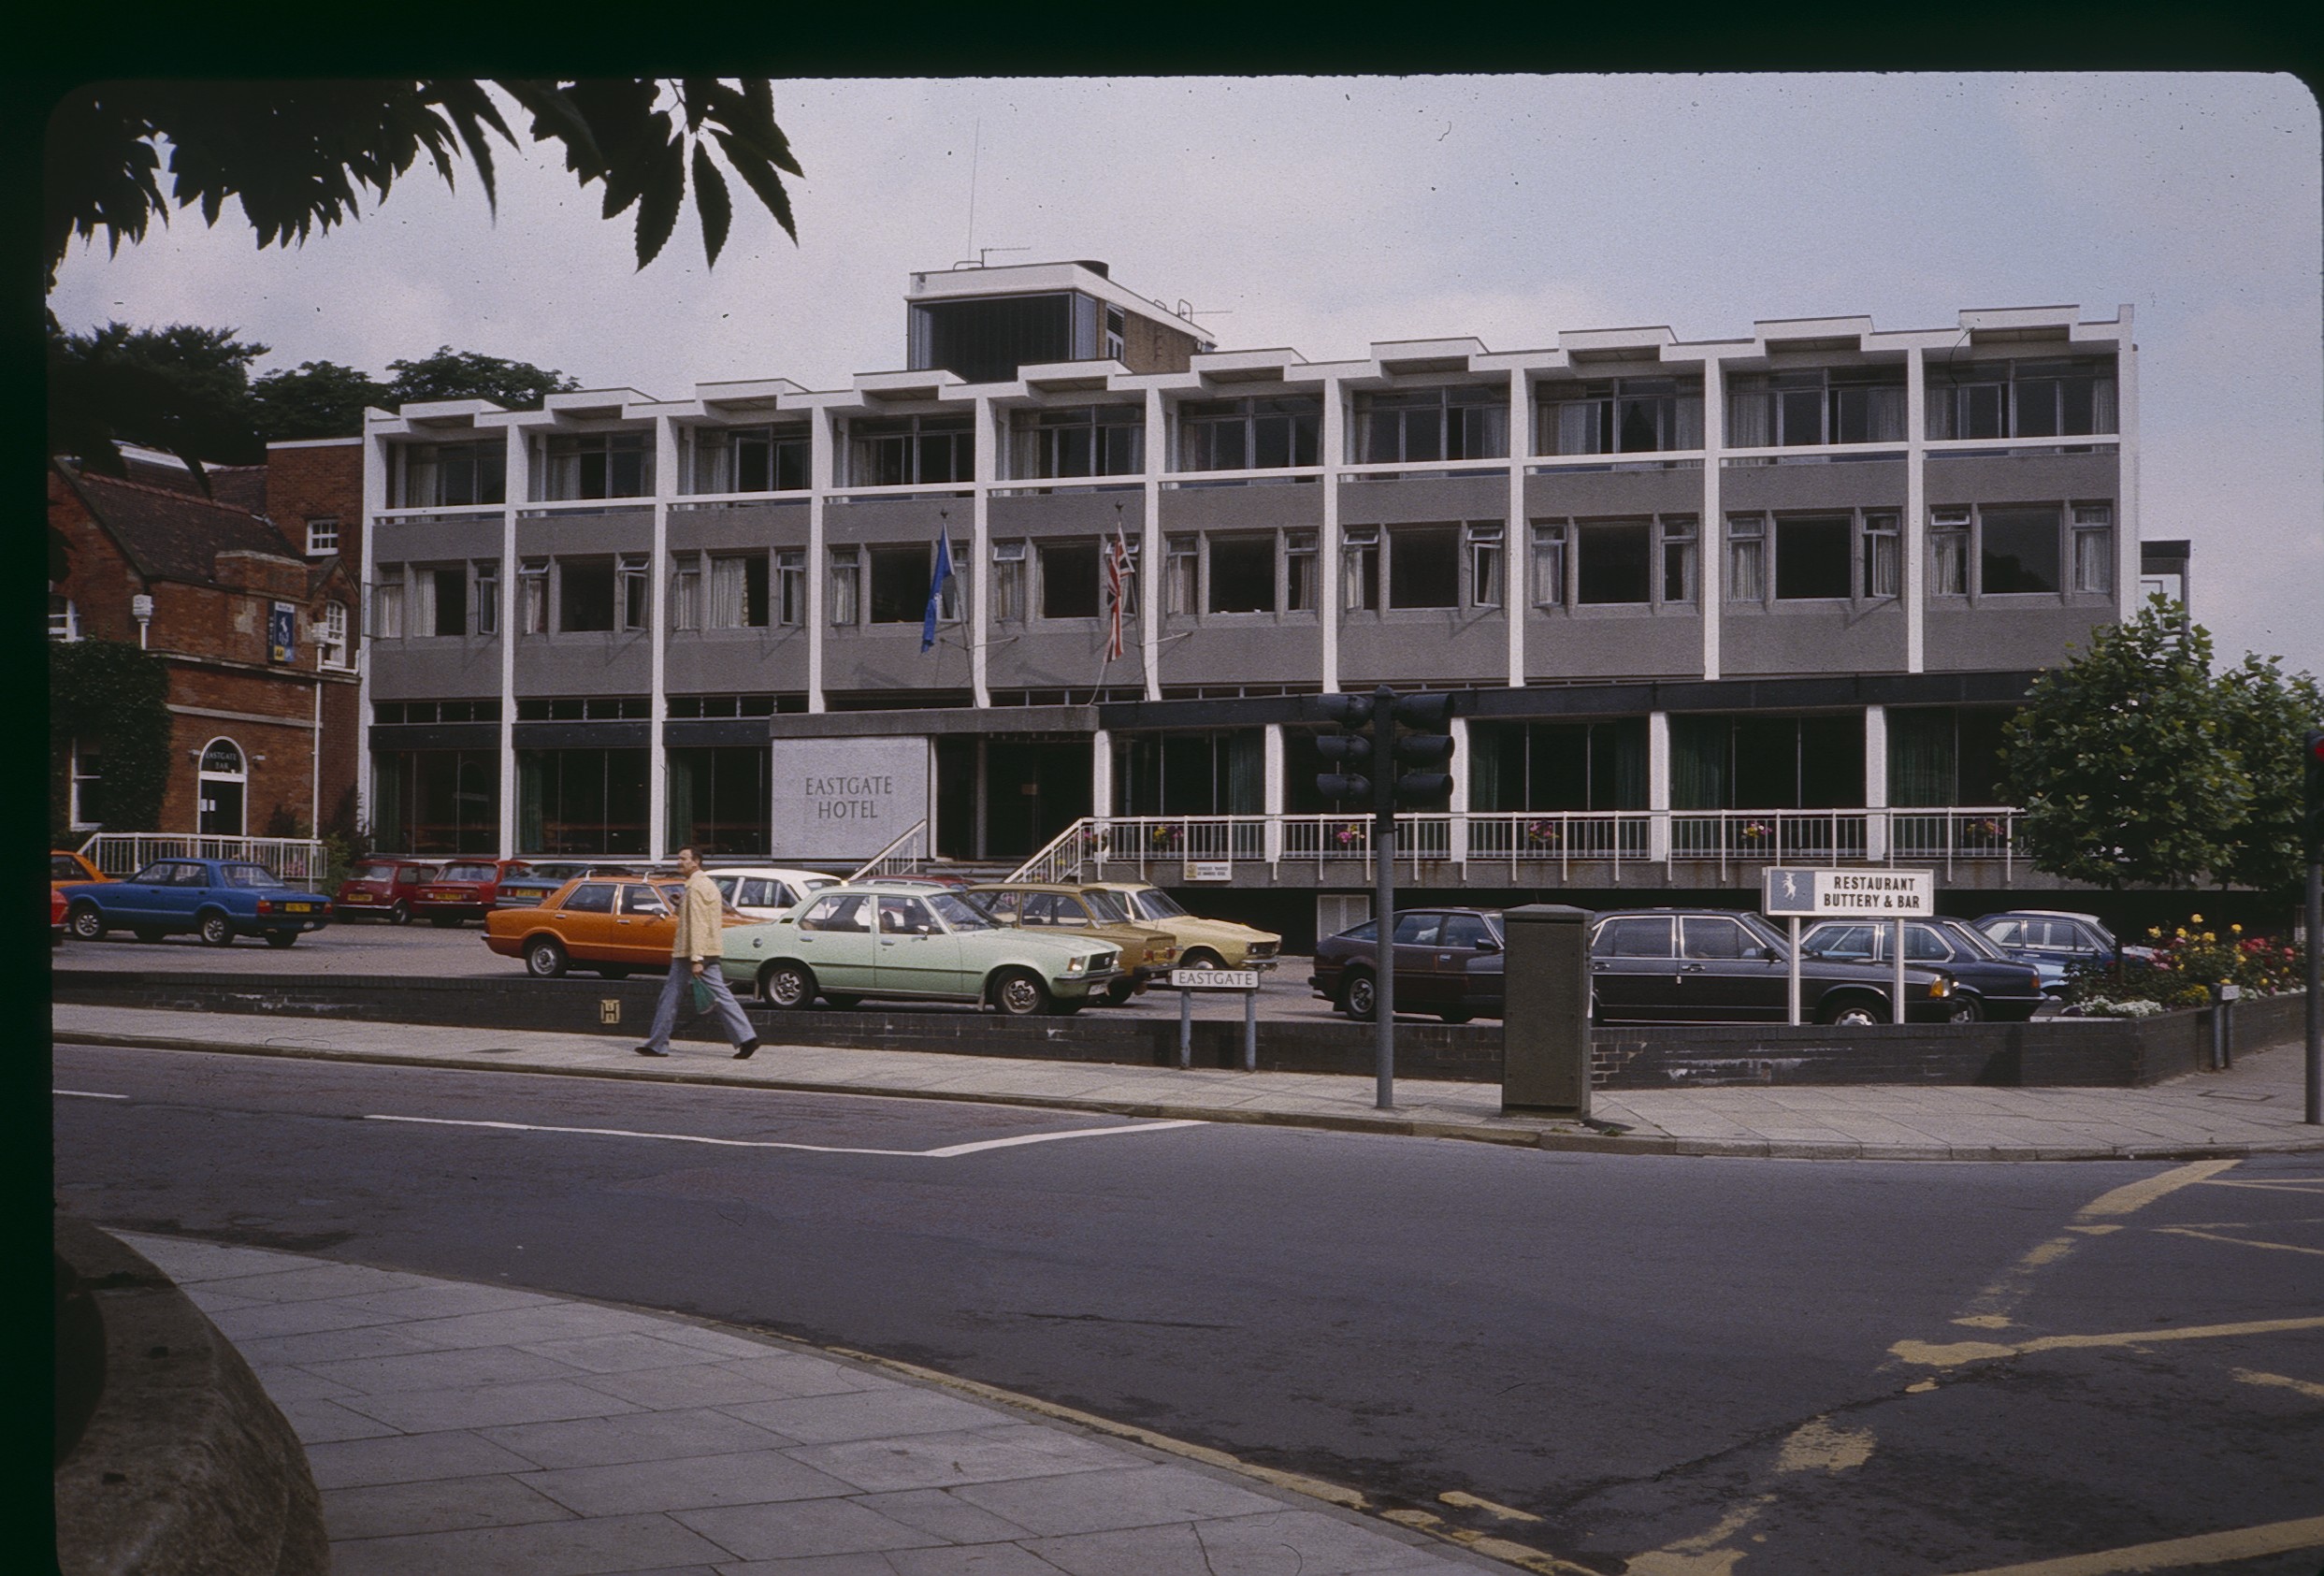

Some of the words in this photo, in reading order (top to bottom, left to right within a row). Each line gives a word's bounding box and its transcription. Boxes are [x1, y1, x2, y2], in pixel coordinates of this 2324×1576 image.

[205, 751, 237, 760] EASTGATE
[805, 775, 892, 796] EASTGATE
[818, 801, 878, 819] HOTEL
[1834, 876, 1915, 891] RESTAURANT
[1824, 893, 1880, 907] BUTTERY
[1884, 895, 1893, 908] &
[1898, 895, 1920, 908] BAR
[1178, 972, 1252, 986] EASTGATE
